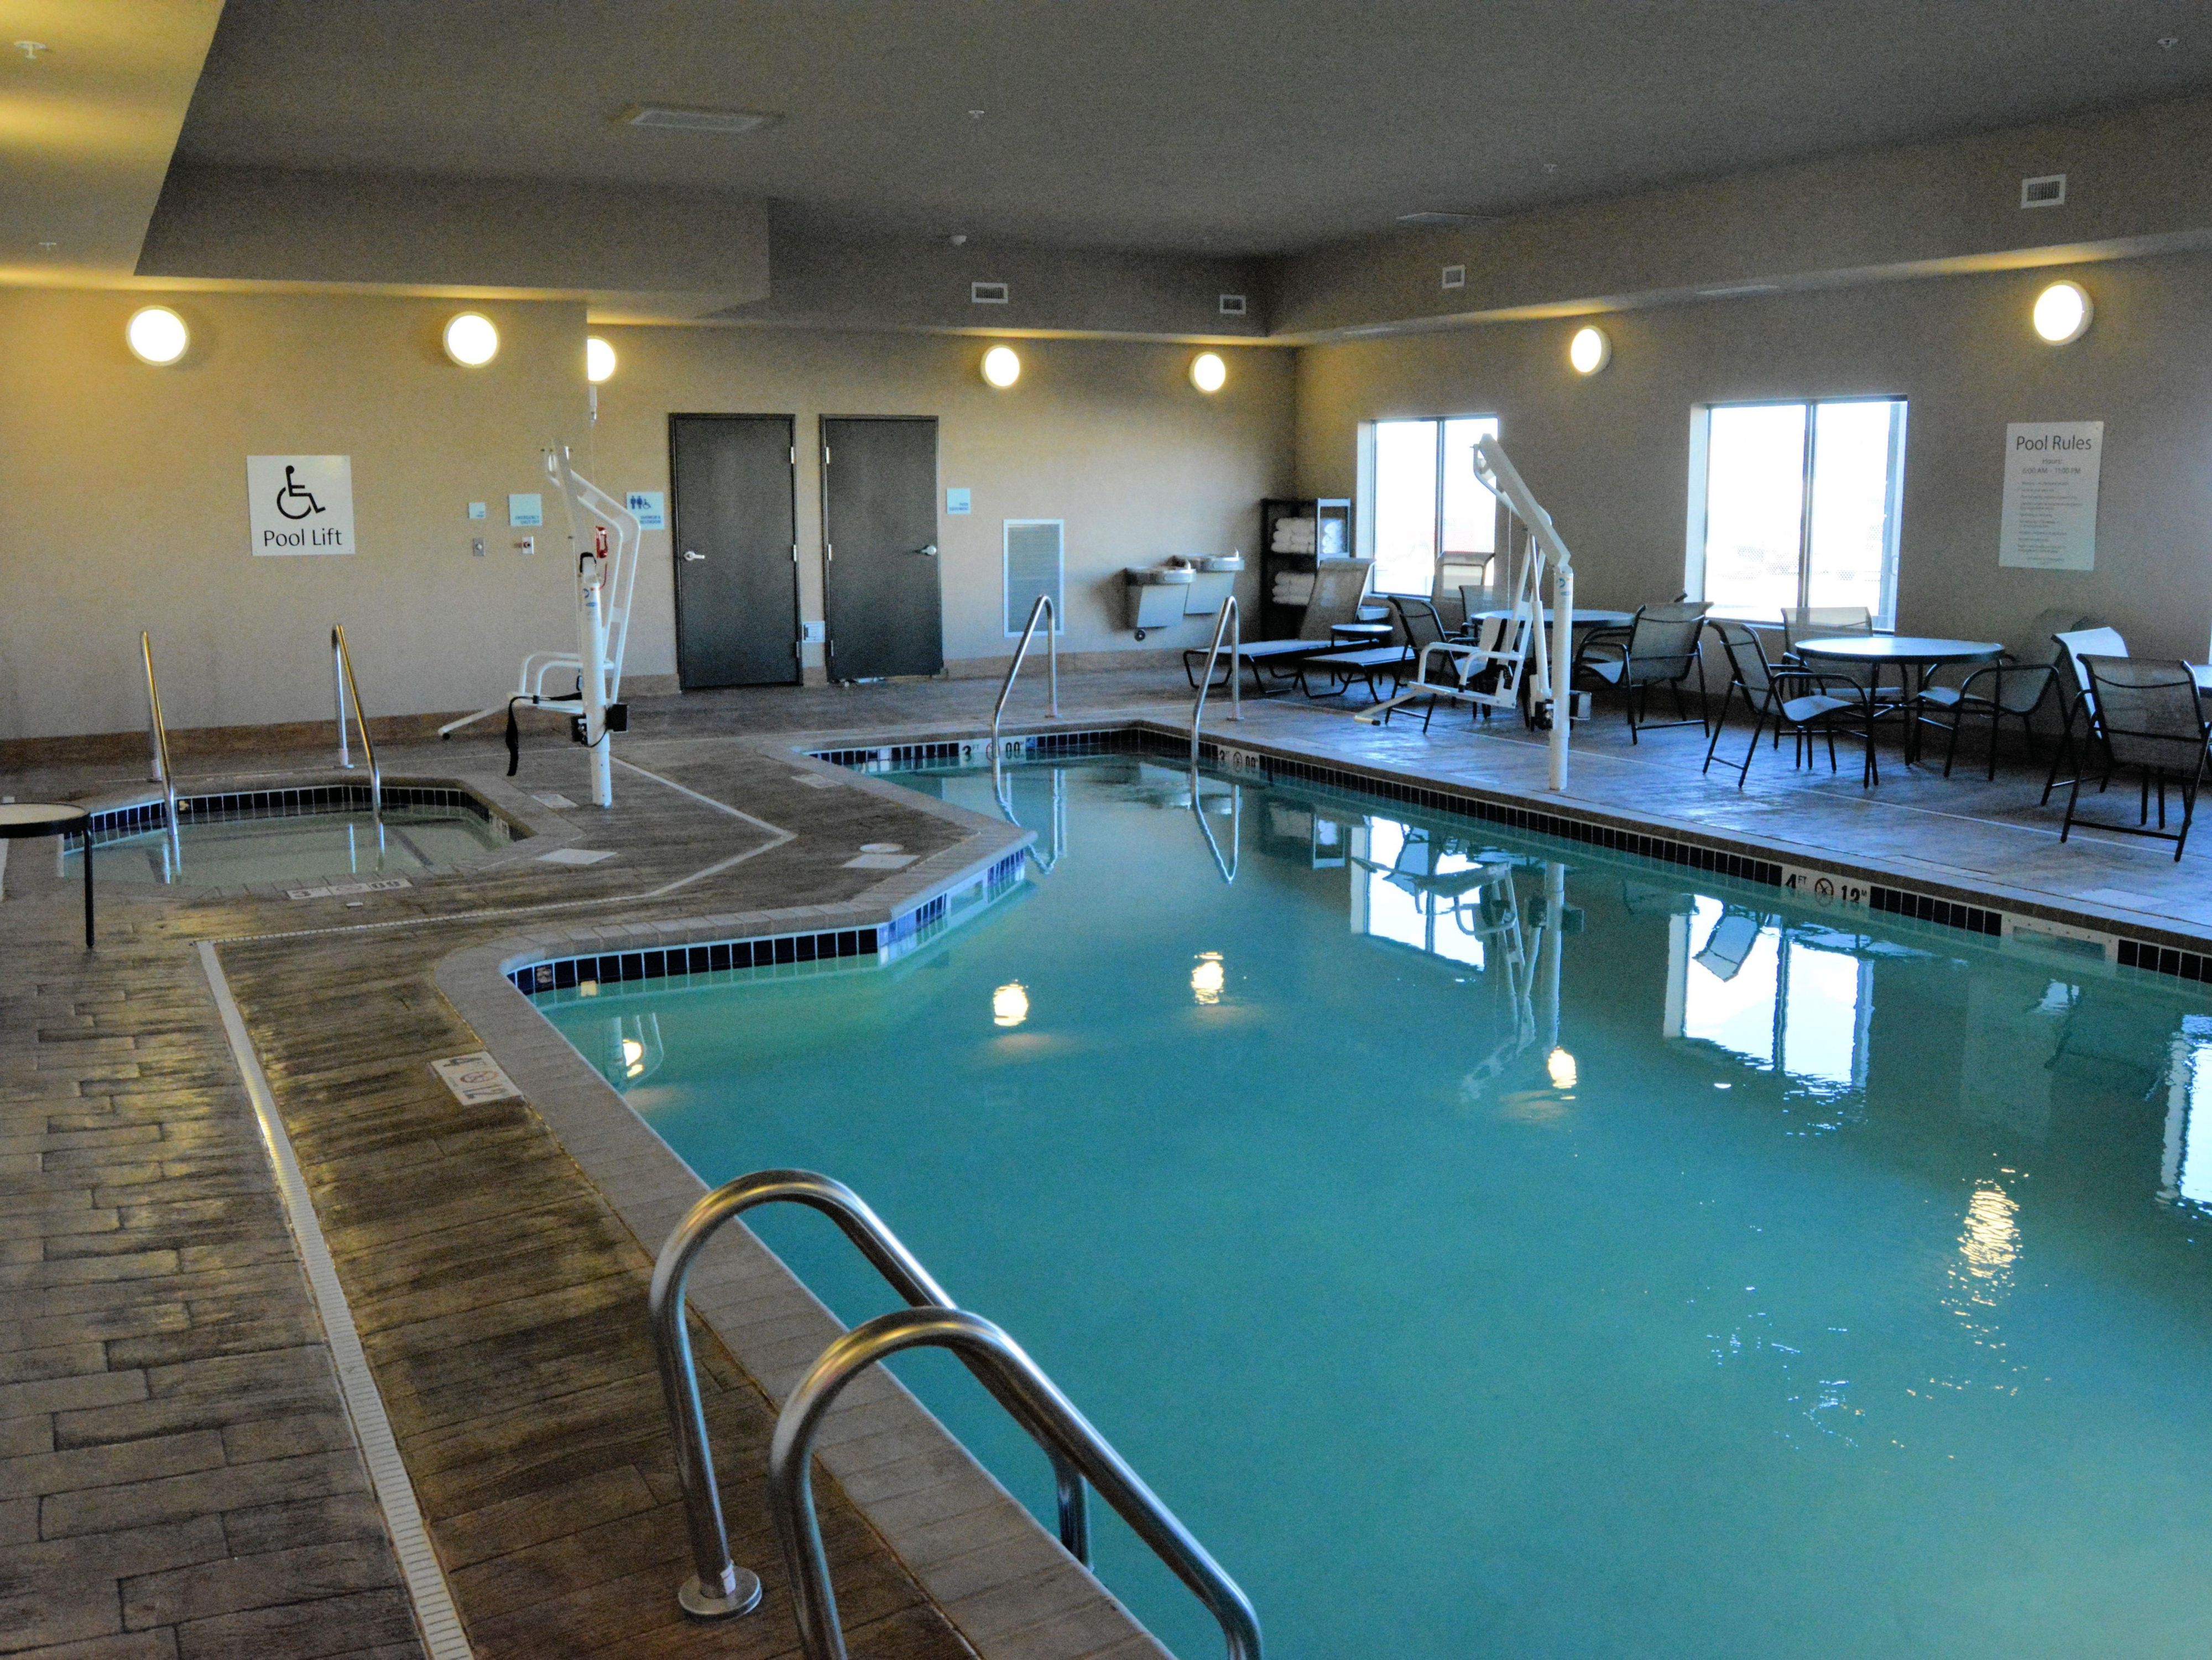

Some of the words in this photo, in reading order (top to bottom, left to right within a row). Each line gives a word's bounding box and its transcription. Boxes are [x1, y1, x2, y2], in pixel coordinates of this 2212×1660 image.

[2016, 434, 2048, 451] Pool
[2052, 434, 2092, 450] Rules
[263, 528, 305, 547] Pool
[312, 528, 343, 545] Lift
